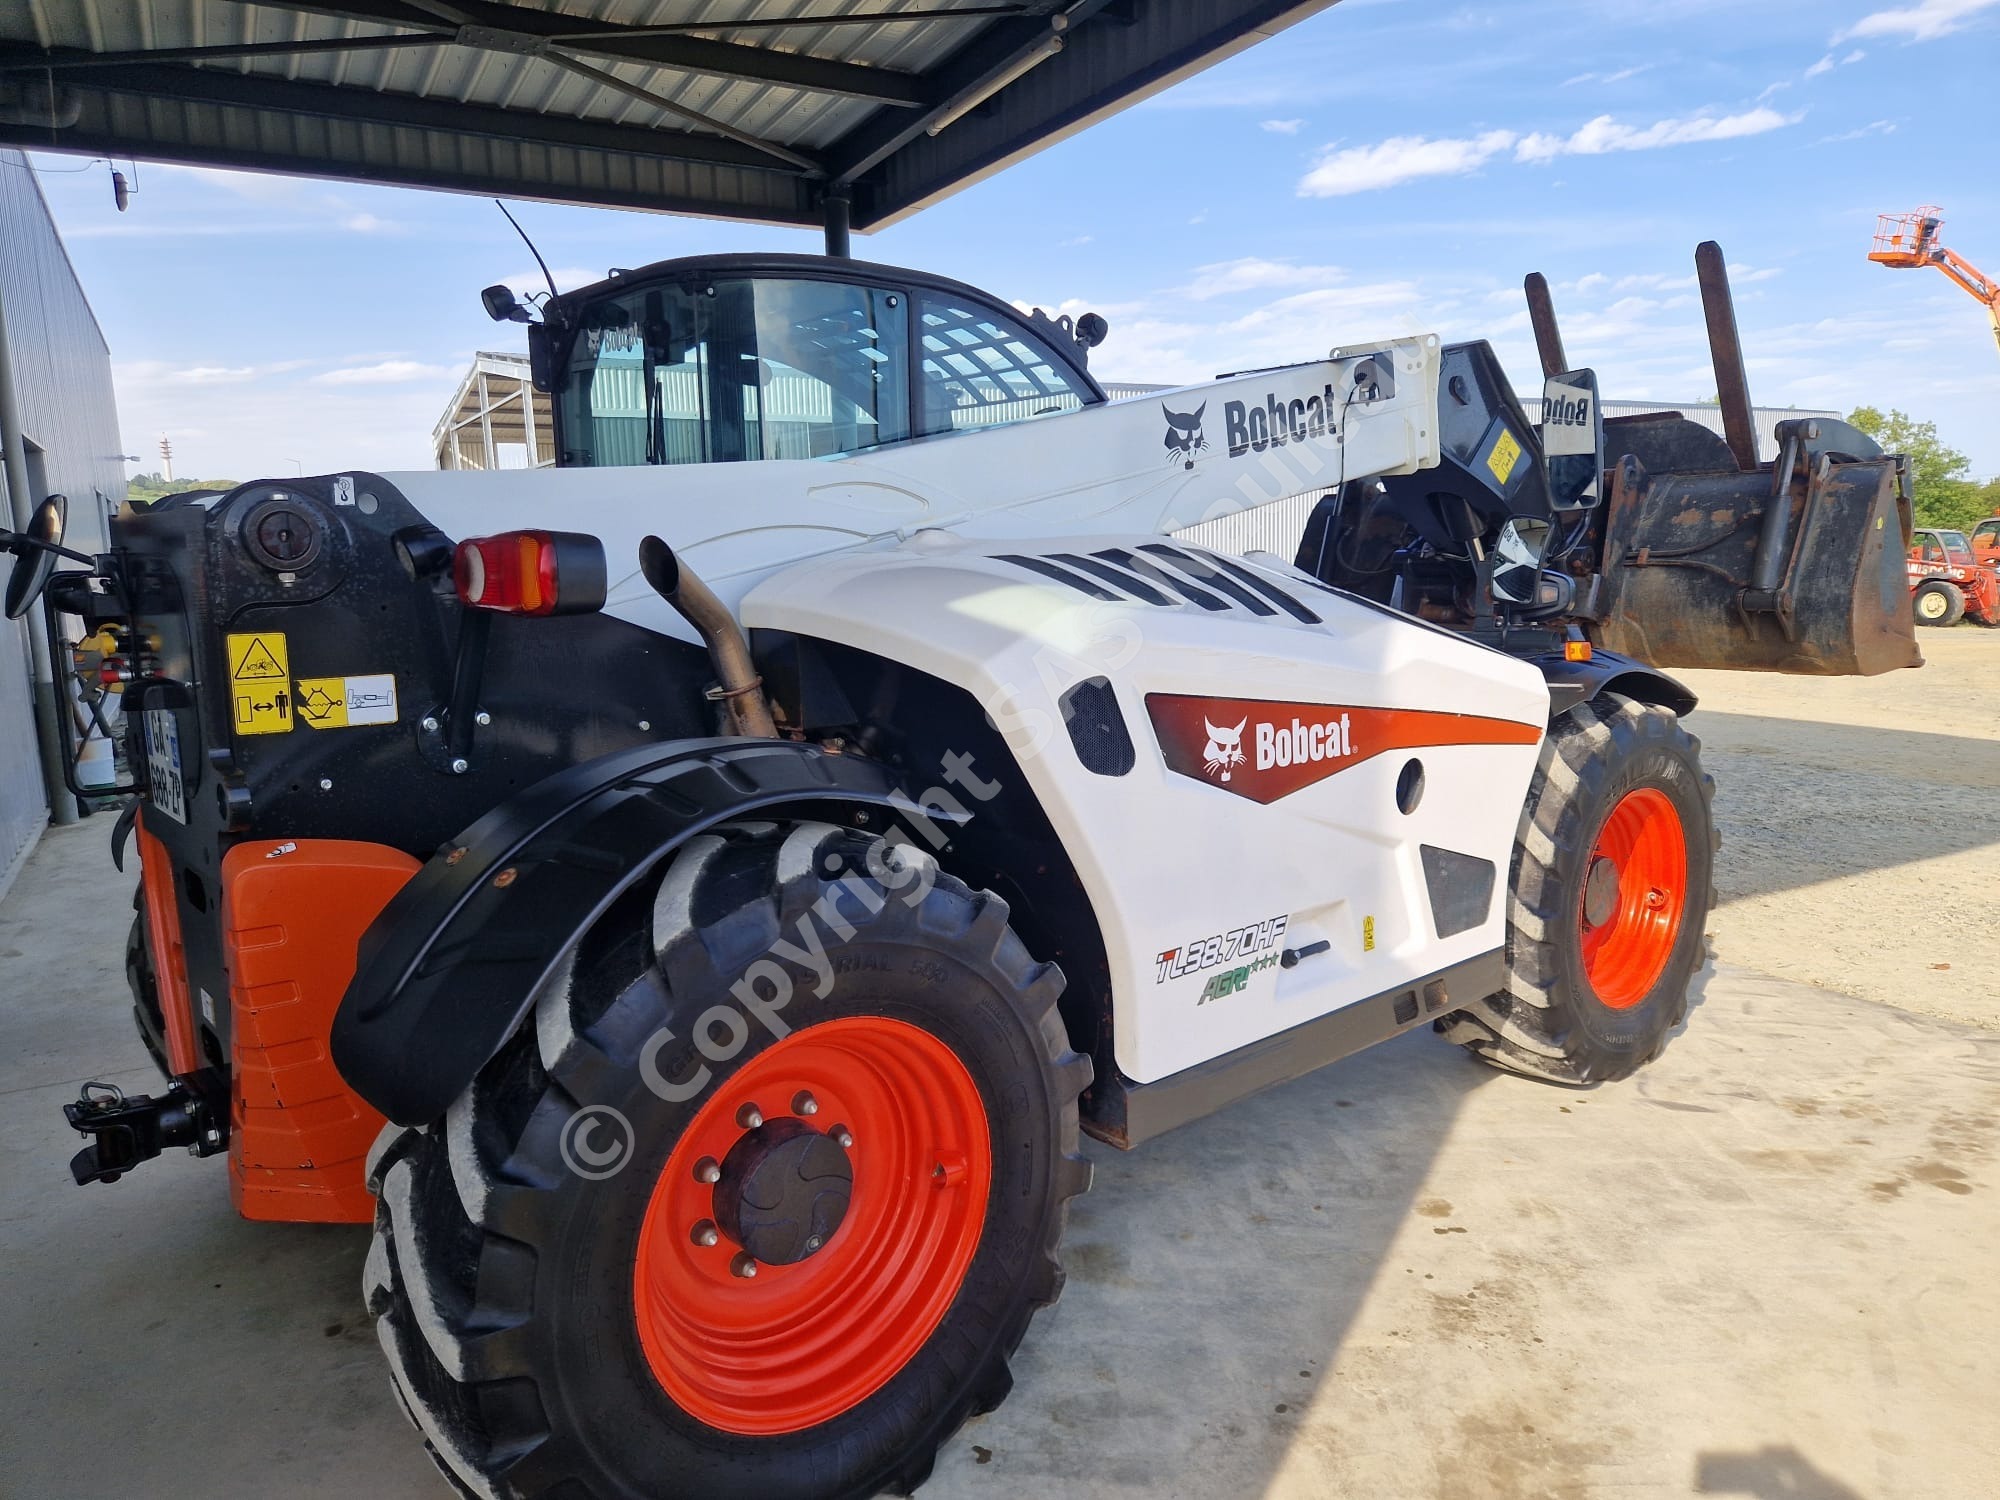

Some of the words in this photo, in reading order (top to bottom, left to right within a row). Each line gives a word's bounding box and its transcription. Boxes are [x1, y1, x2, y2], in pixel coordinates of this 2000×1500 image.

[1224, 384, 1337, 458] Bobcat
[1255, 713, 1351, 771] Bobcat
[1156, 914, 1289, 984] TL38.70HF
